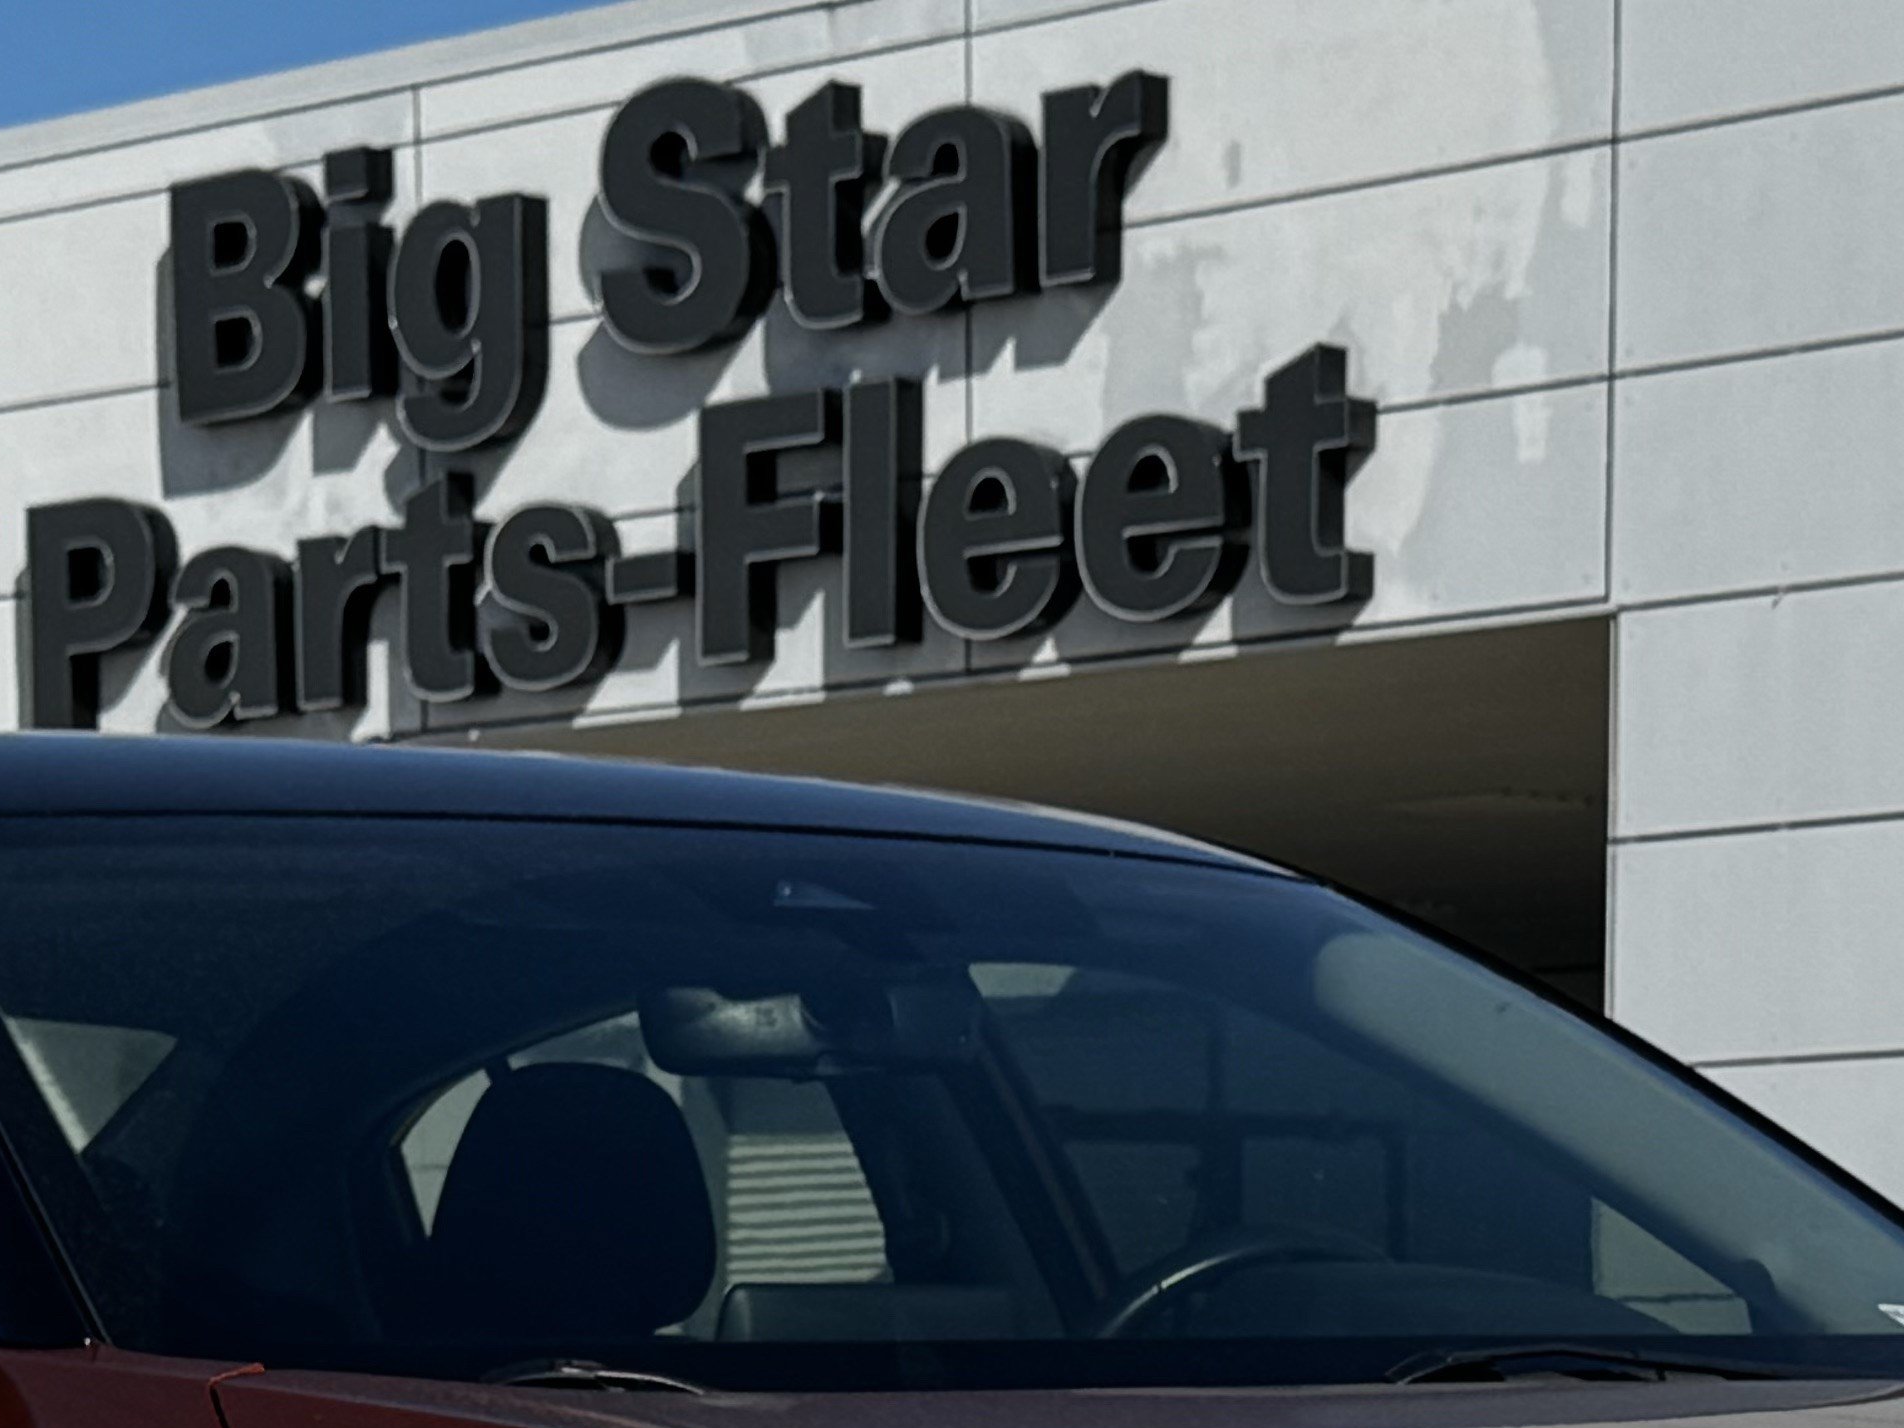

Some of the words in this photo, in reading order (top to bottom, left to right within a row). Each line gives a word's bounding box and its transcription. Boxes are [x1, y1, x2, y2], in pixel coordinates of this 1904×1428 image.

[169, 147, 548, 452] Big
[594, 70, 1169, 356] Star
[24, 344, 1377, 731] Parts-Fleet
